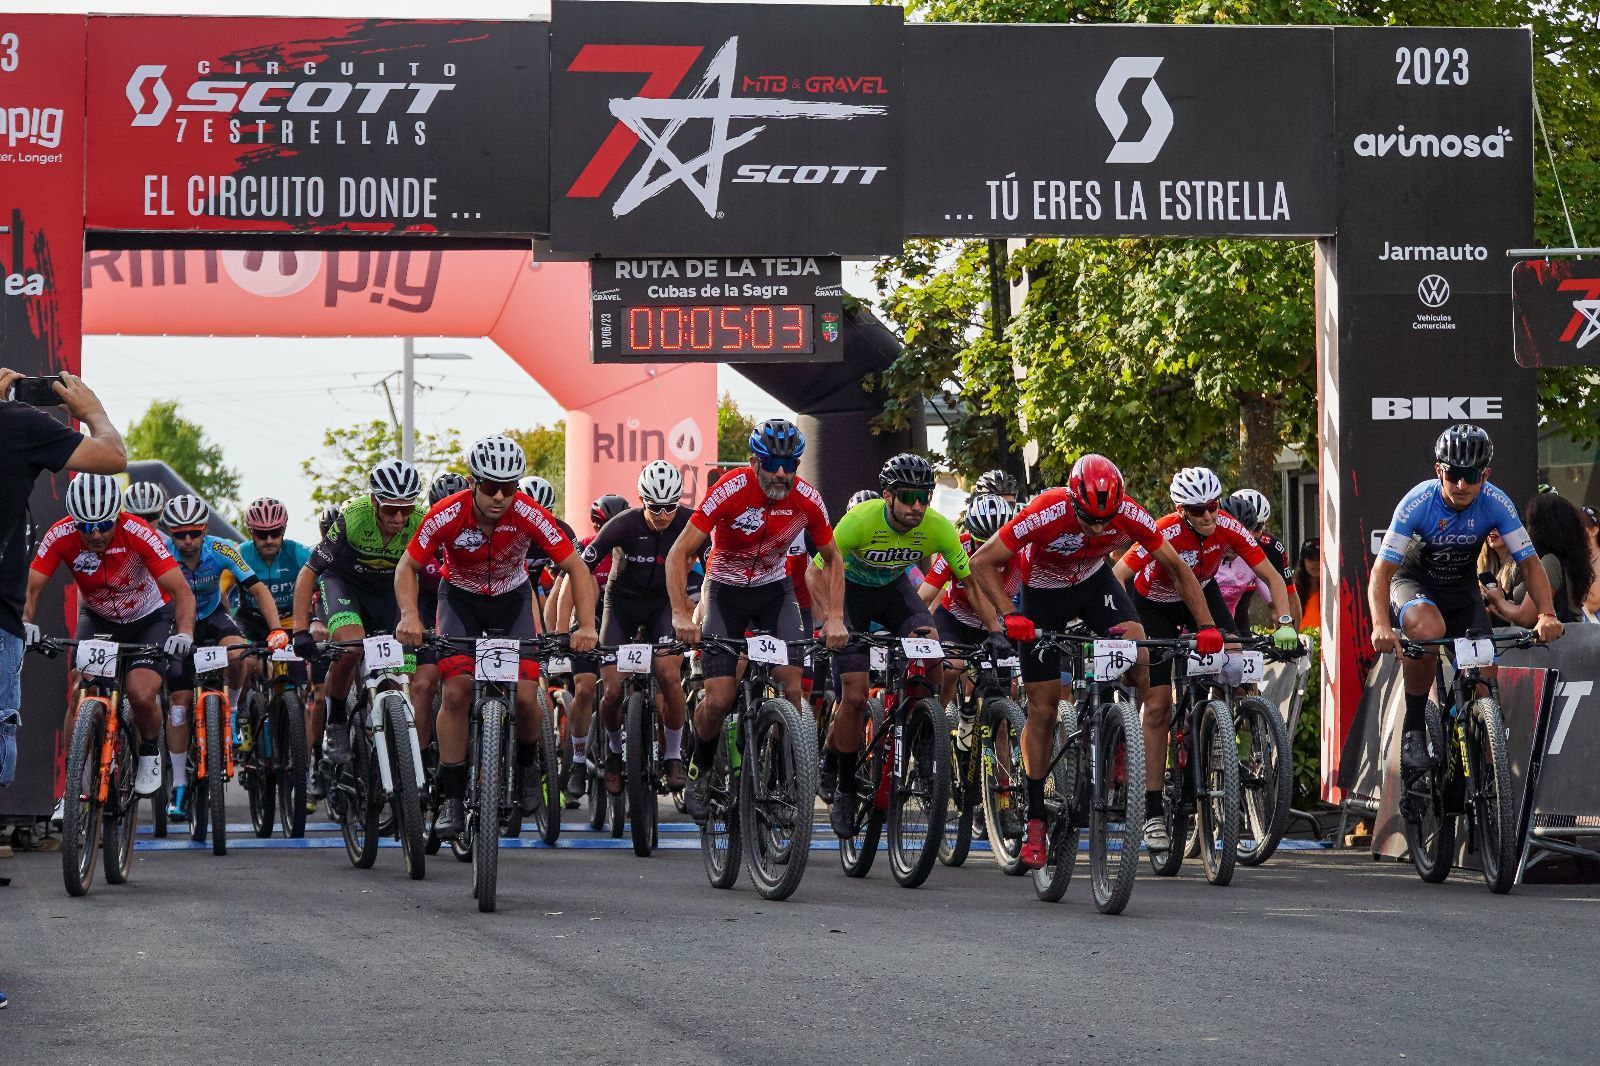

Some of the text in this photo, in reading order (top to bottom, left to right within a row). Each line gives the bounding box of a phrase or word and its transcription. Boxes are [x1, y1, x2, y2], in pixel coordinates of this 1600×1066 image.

[198, 61, 457, 77] CIRCUITO
[1395, 47, 1470, 86] 2023
[742, 75, 888, 94] MTB & GRAVEL
[177, 81, 457, 114] SCOTT
[1354, 125, 1507, 159] avimosa
[18, 153, 63, 165] Longer!
[732, 165, 887, 185] SCOTT
[144, 175, 174, 217] EL
[187, 175, 324, 217] CIRCUITO
[339, 177, 438, 219] DONDE
[986, 173, 1019, 221] TÚ
[1033, 181, 1102, 221] ERES
[1114, 182, 1148, 221] LA
[1160, 181, 1291, 221] ESTRELLA
[1378, 242, 1488, 262] Jarmauto
[615, 257, 820, 279] RUTA DE LA TEJA
[648, 283, 787, 299] Cubas de la Sagra
[815, 289, 842, 297] GRAVEL
[601, 313, 612, 348] 18/06/23
[630, 307, 803, 351] 00:05:03
[1412, 321, 1456, 330] Comerciales
[1371, 397, 1503, 421] BIKE
[864, 548, 923, 562] mitto
[376, 642, 391, 658] 15
[759, 639, 776, 654] 34
[914, 645, 932, 655] 43
[1471, 640, 1479, 658] 1
[88, 647, 106, 666] 38
[205, 651, 217, 662] 31
[493, 651, 502, 669] 3
[627, 650, 642, 664] 42
[1109, 650, 1124, 669] 16
[1242, 658, 1255, 674] 23
